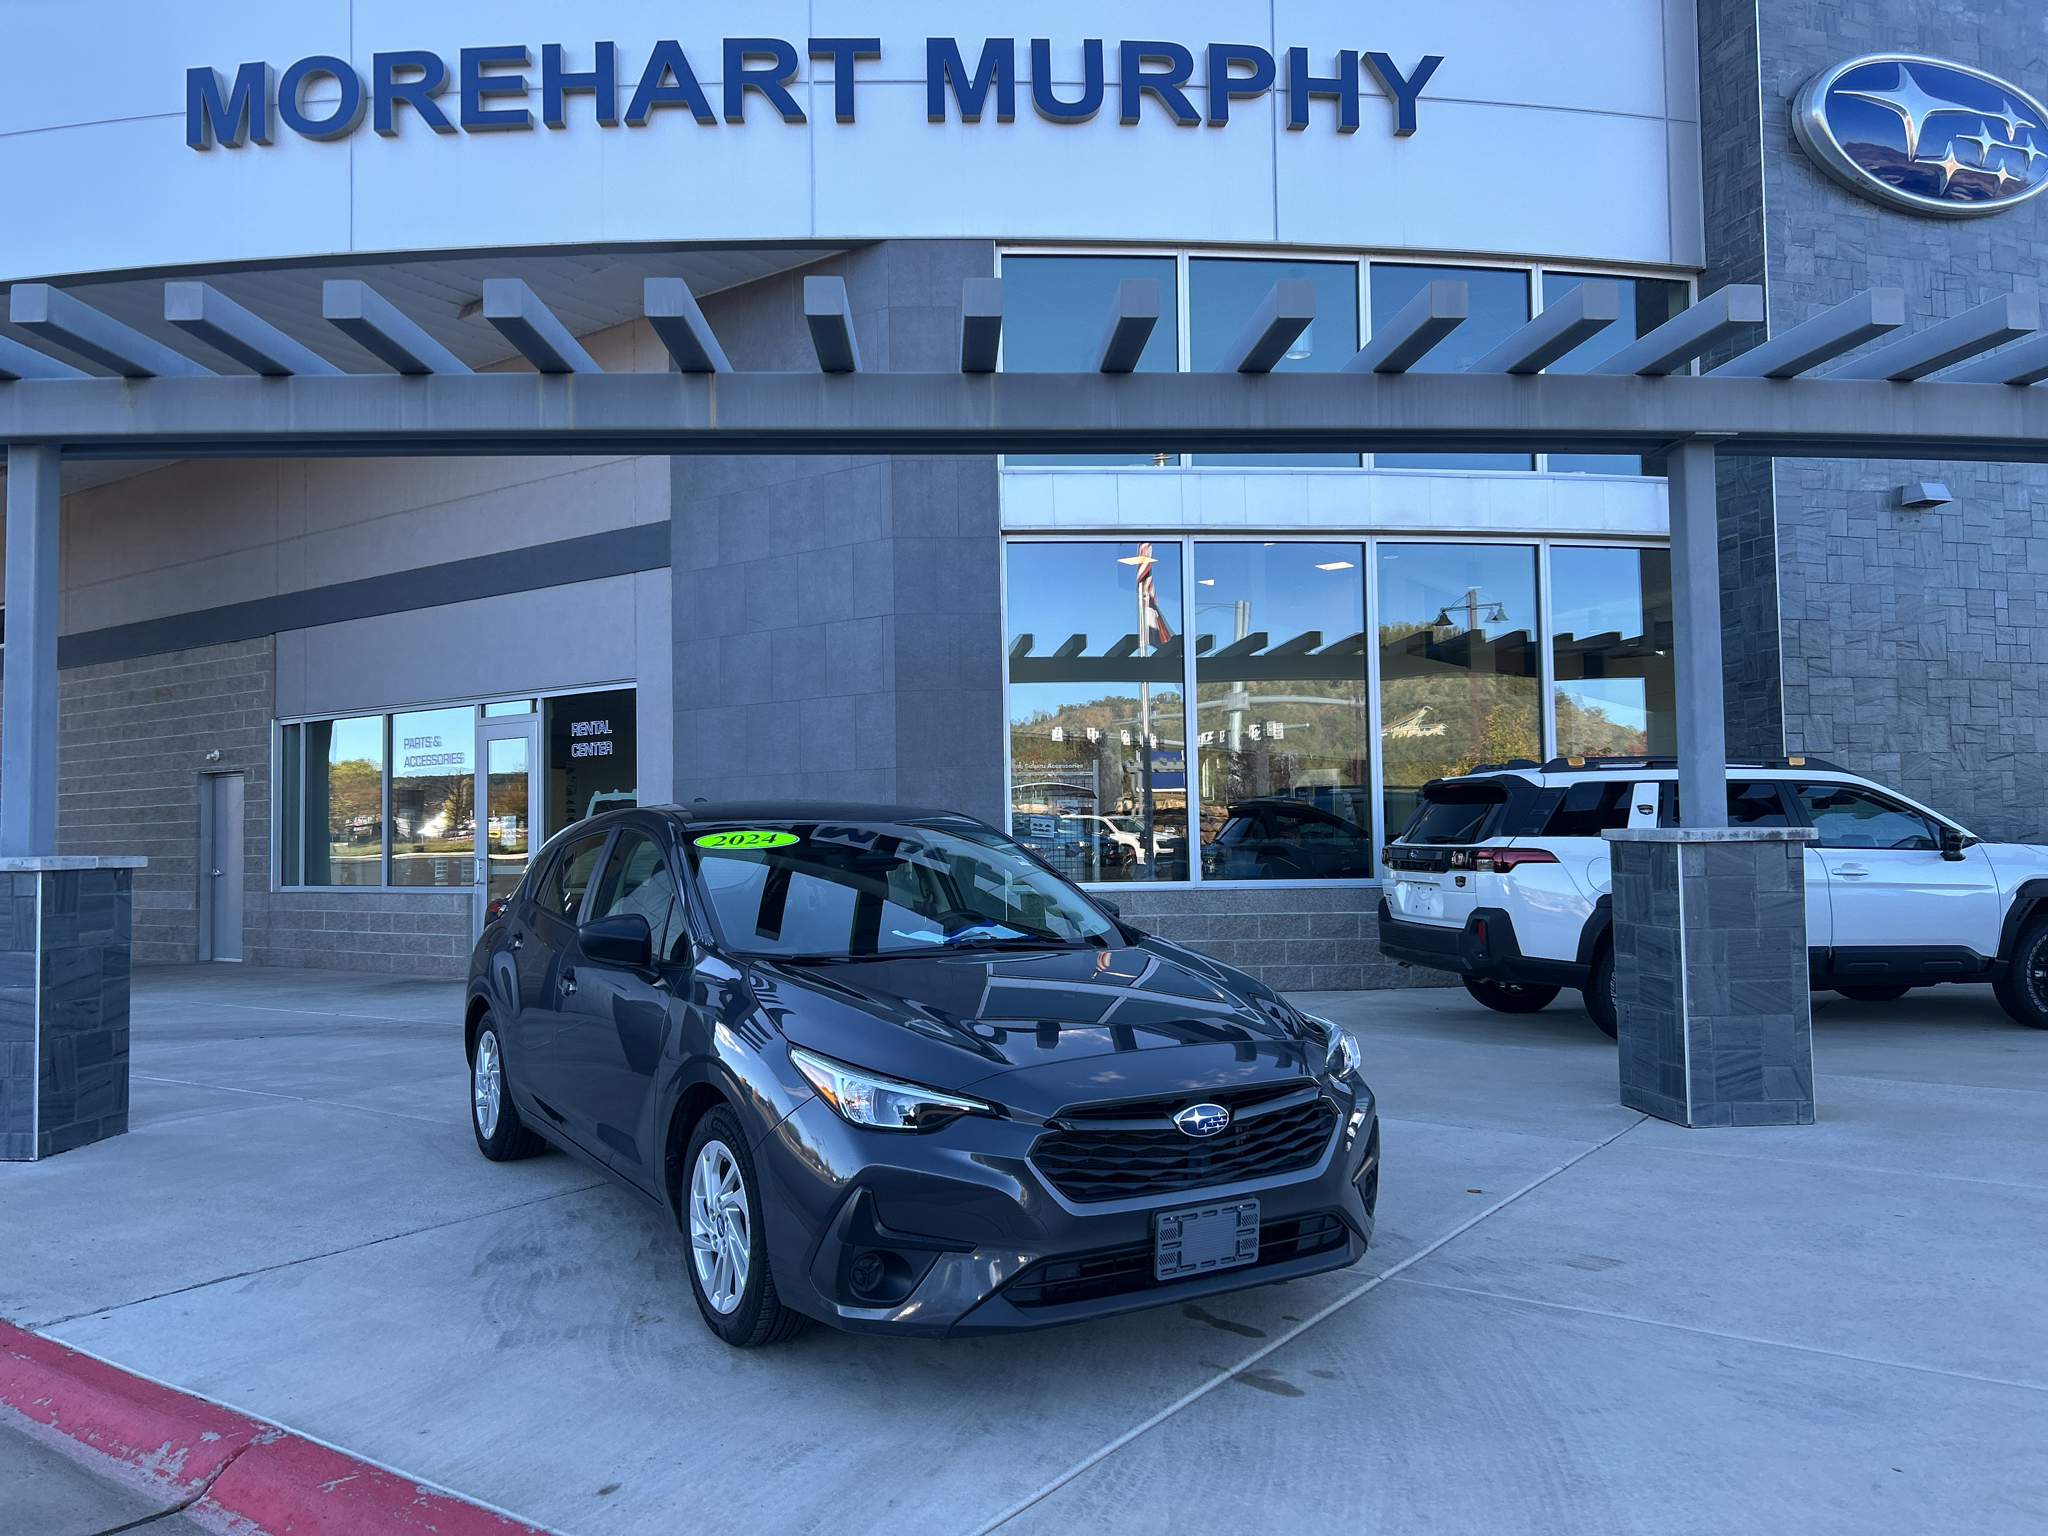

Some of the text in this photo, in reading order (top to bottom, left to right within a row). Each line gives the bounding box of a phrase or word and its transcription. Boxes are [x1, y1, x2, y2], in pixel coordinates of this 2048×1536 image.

[186, 37, 1445, 151] MOREHART MURPHY
[571, 719, 613, 737] RENTAL
[403, 735, 443, 750] PARTS &
[571, 740, 613, 758] CENTER
[403, 751, 465, 768] ACCESSORIES
[711, 833, 778, 847] 2024
